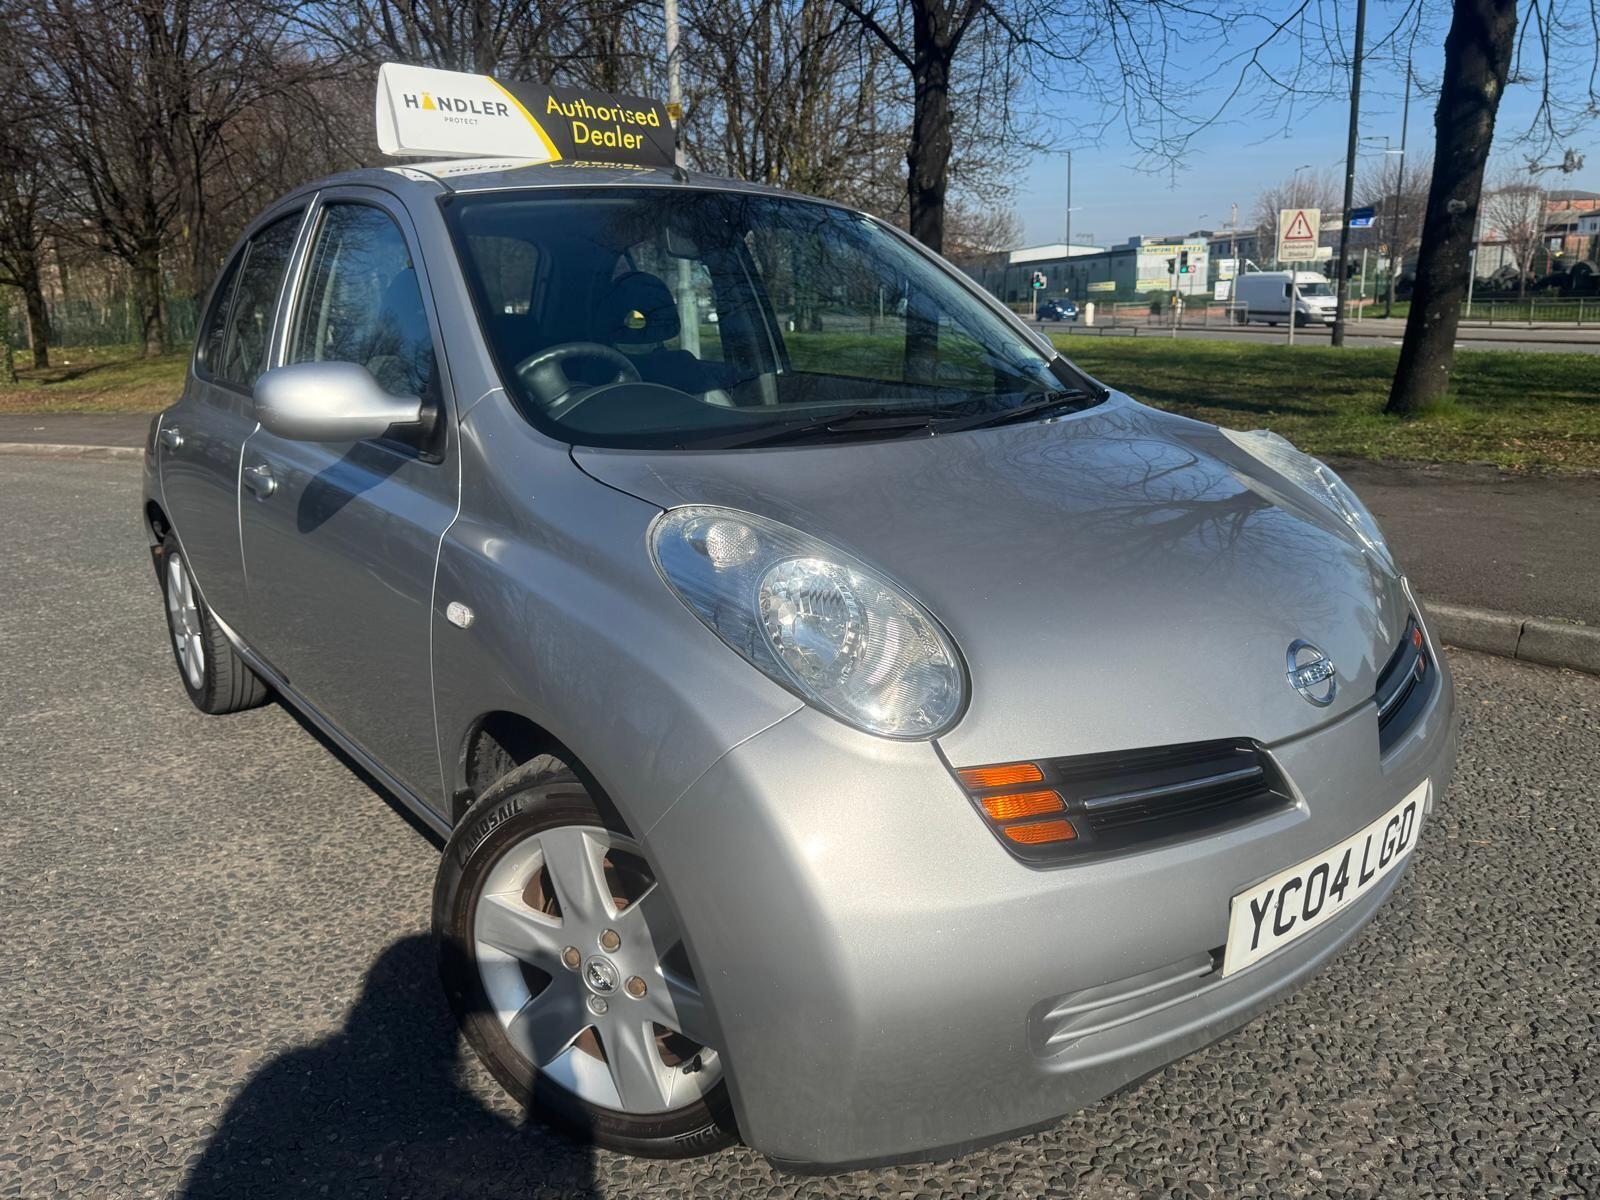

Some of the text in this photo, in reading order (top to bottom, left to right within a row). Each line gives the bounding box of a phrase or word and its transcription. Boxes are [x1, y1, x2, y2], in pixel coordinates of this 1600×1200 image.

[444, 116, 478, 125] PROTECT
[547, 95, 660, 128] Authorised
[573, 120, 644, 149] Dealer
[1250, 801, 1416, 951] YC04 LGD
